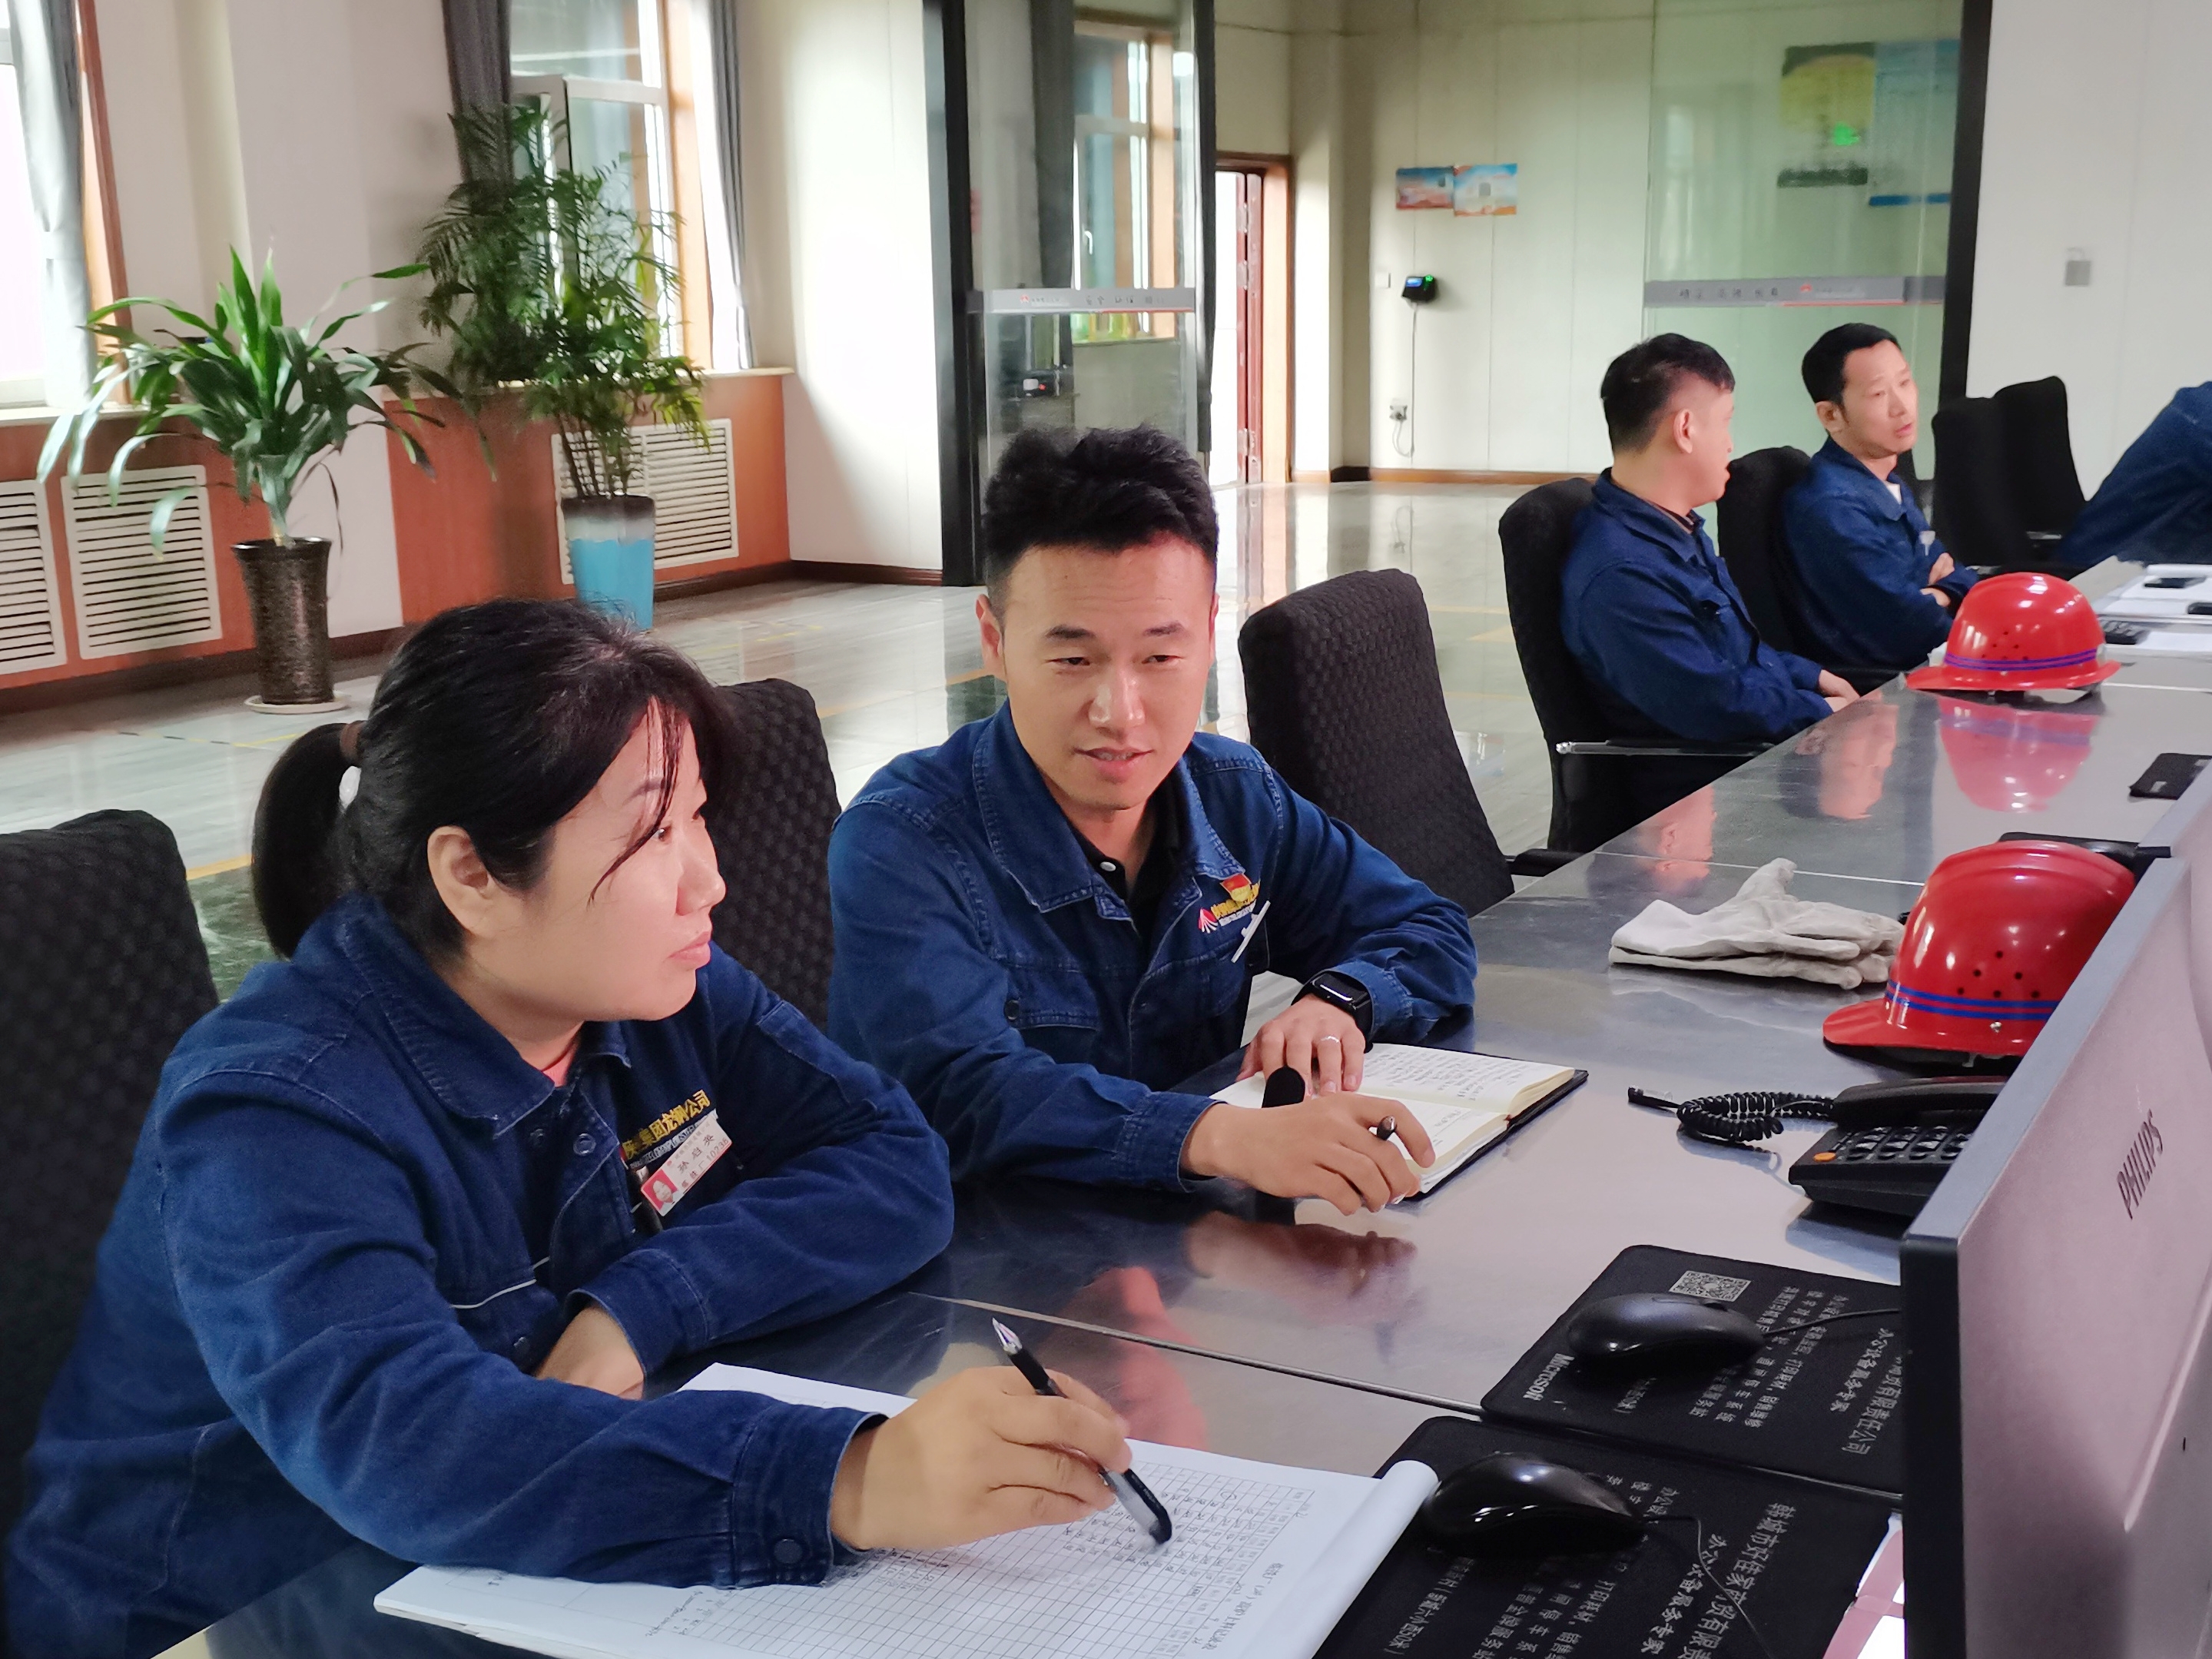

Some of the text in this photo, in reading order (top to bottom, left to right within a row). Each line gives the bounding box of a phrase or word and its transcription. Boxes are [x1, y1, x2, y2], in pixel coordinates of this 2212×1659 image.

[2117, 1109, 2163, 1219] PHILIPS
[1521, 1352, 1575, 1402] Microsoft
[1829, 1328, 1895, 1412] 办公设备服务专家
[1637, 1533, 1732, 1655] 办公设备服务专家
